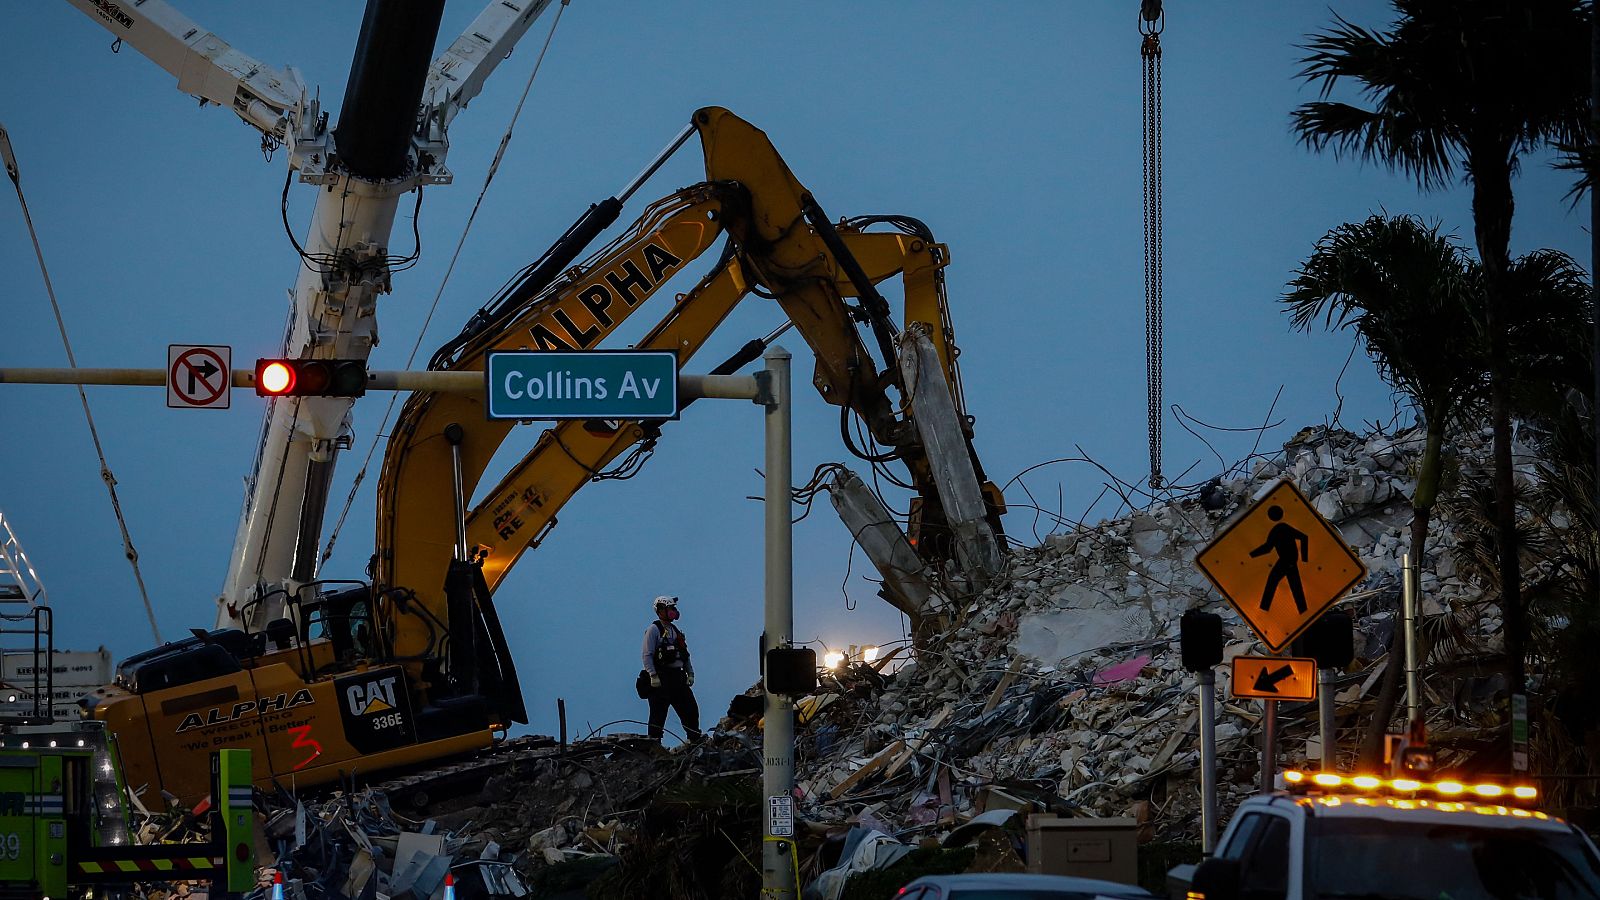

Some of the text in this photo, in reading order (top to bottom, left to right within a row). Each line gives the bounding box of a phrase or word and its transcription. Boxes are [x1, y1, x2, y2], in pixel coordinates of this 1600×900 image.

[529, 242, 683, 350] ALPHA
[504, 370, 661, 400] Collins Av
[175, 688, 316, 733] ALPHA
[346, 676, 397, 716] CAT
[201, 711, 293, 736] WRECKING
[213, 731, 252, 746] Break
[372, 712, 403, 731] 336E
[288, 725, 323, 770] 3
